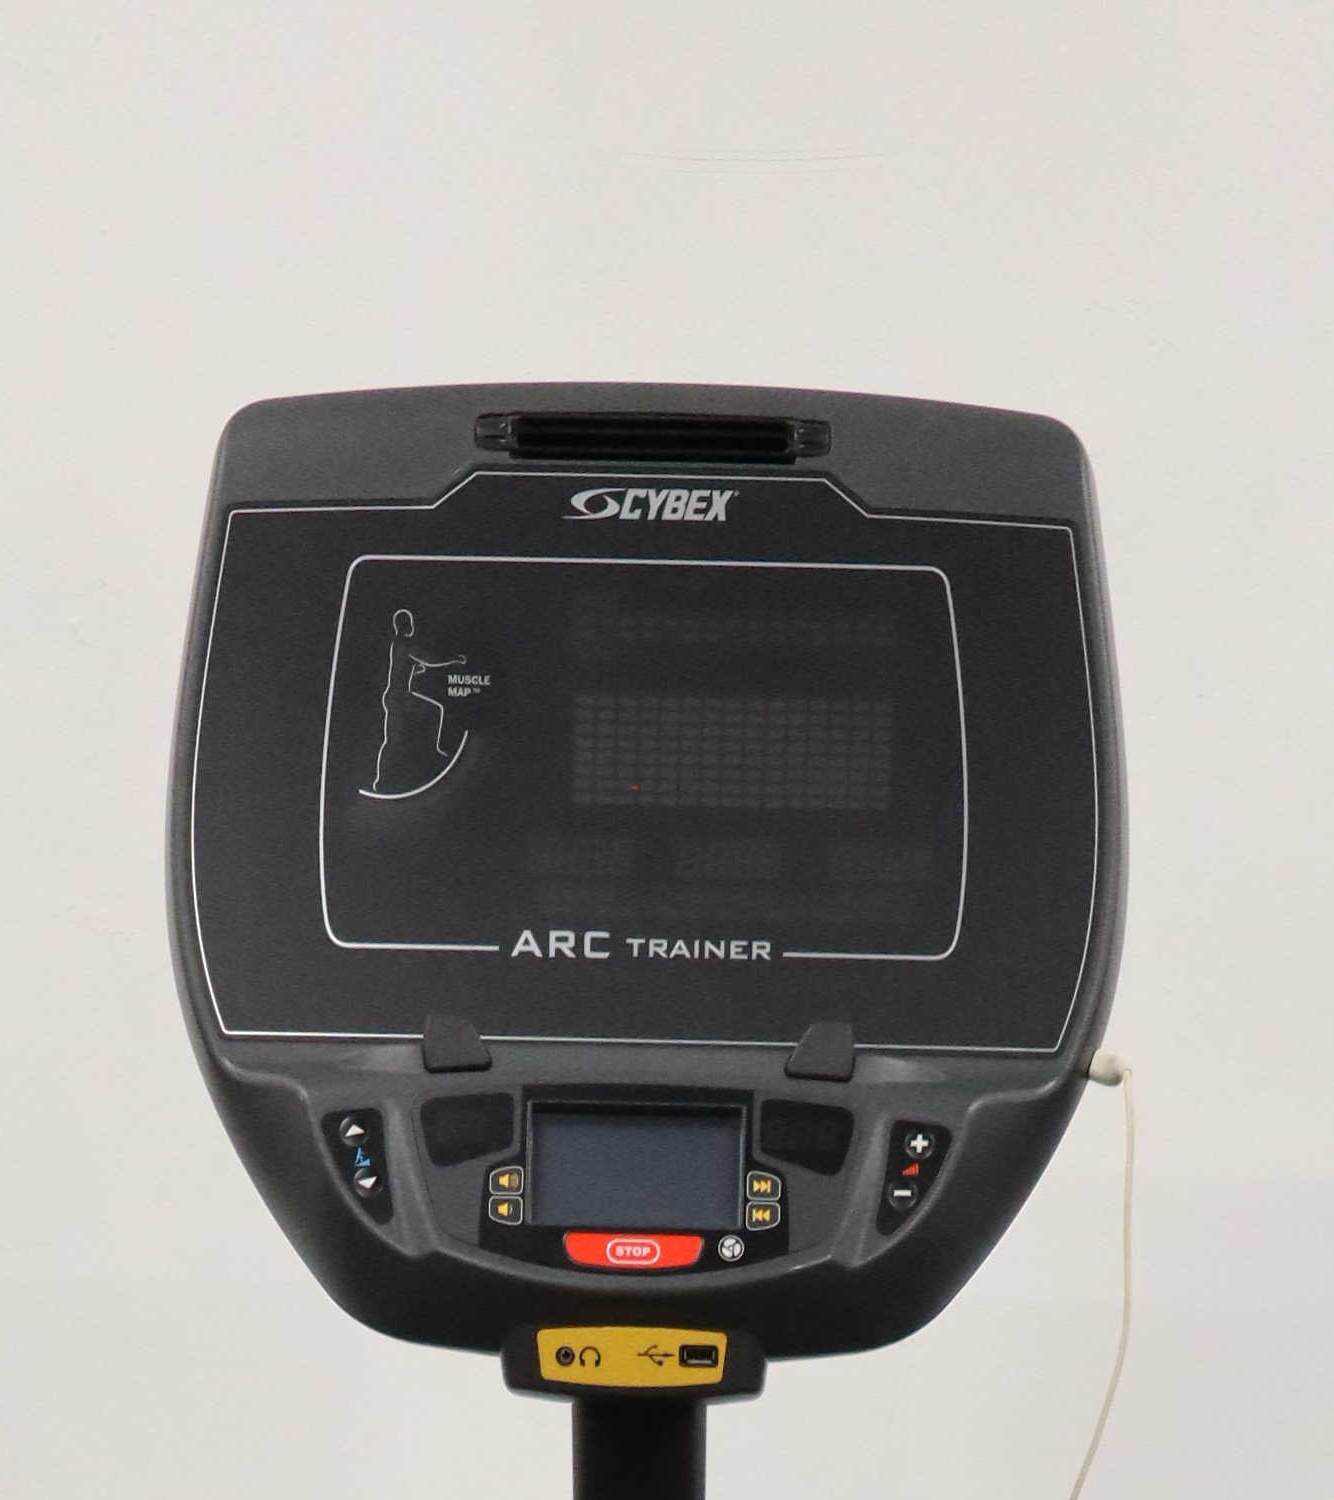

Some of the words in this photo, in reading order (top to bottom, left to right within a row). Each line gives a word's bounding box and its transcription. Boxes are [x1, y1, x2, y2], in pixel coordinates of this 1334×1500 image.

[619, 488, 734, 521] CYBEX
[448, 674, 491, 685] MUSCLE
[511, 930, 610, 959] ARC
[626, 938, 771, 960] TRAINER
[615, 1246, 651, 1256] STOP
